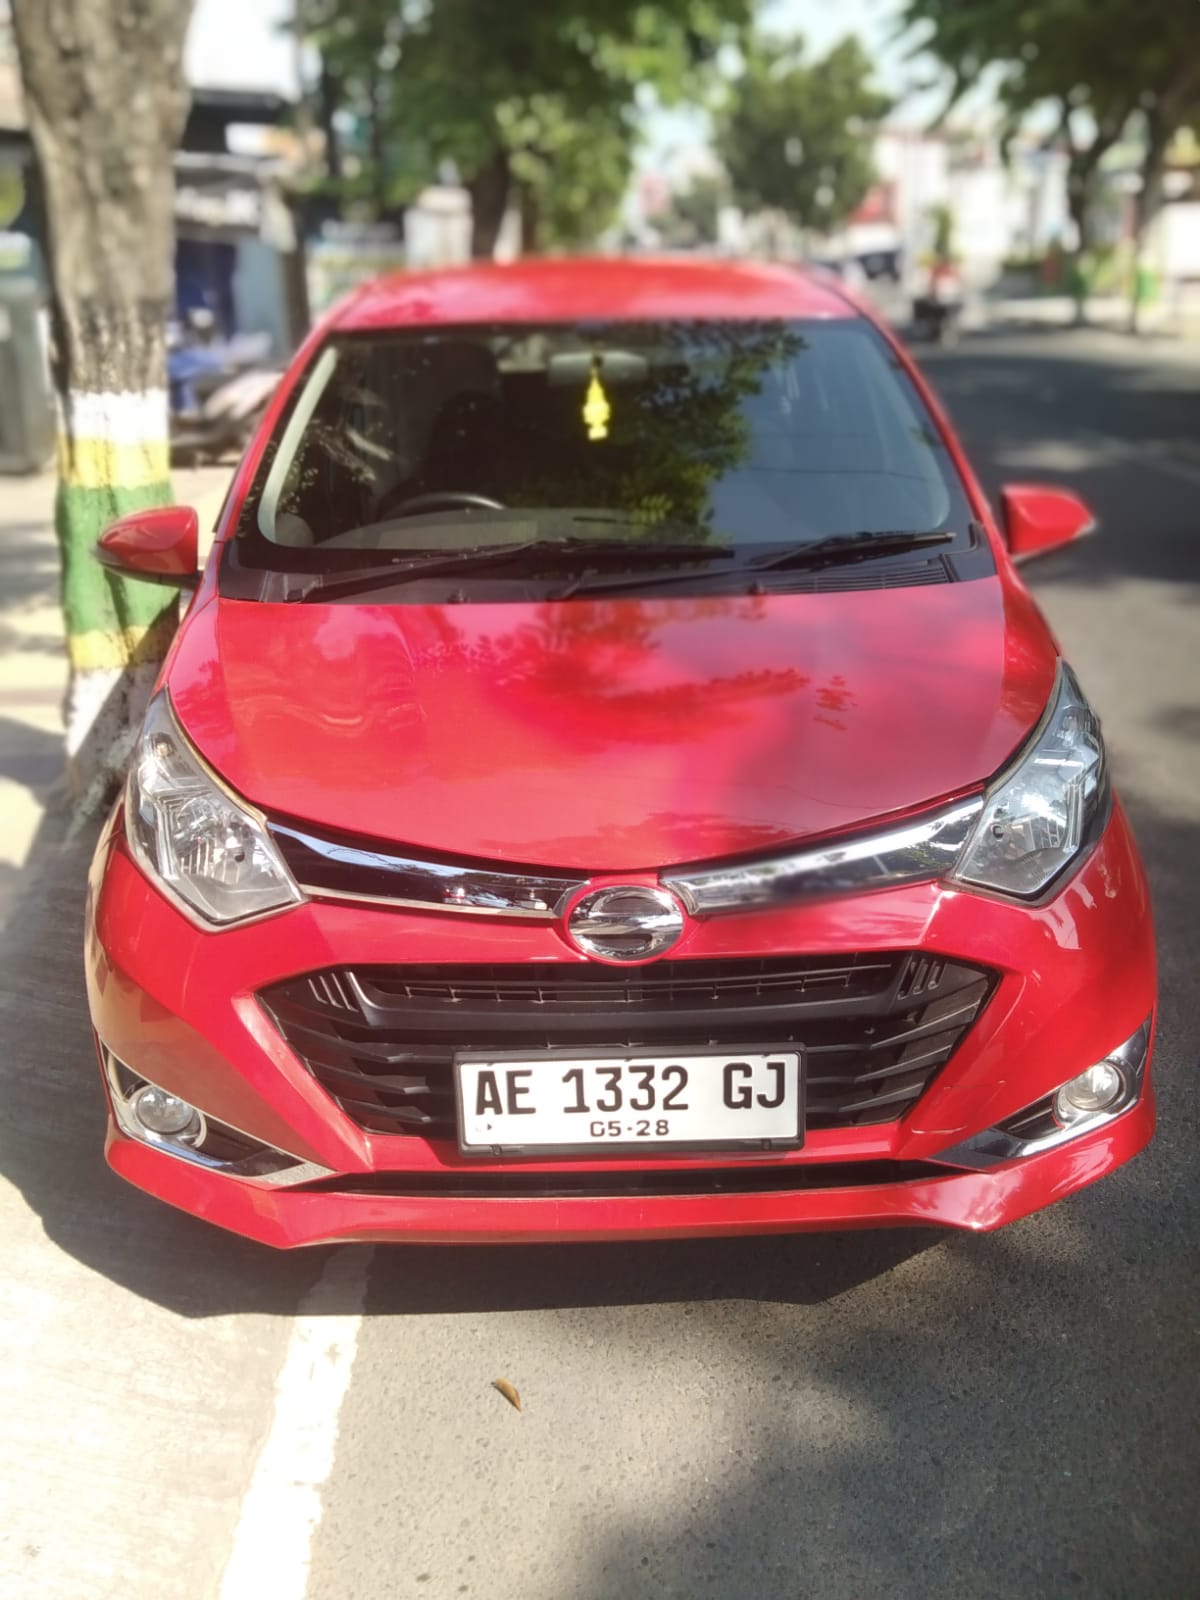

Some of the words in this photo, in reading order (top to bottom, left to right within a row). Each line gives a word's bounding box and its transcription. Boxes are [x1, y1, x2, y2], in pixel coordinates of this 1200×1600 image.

[475, 1069, 536, 1115] AE
[562, 1065, 689, 1113] 1332
[722, 1062, 786, 1109] GJ
